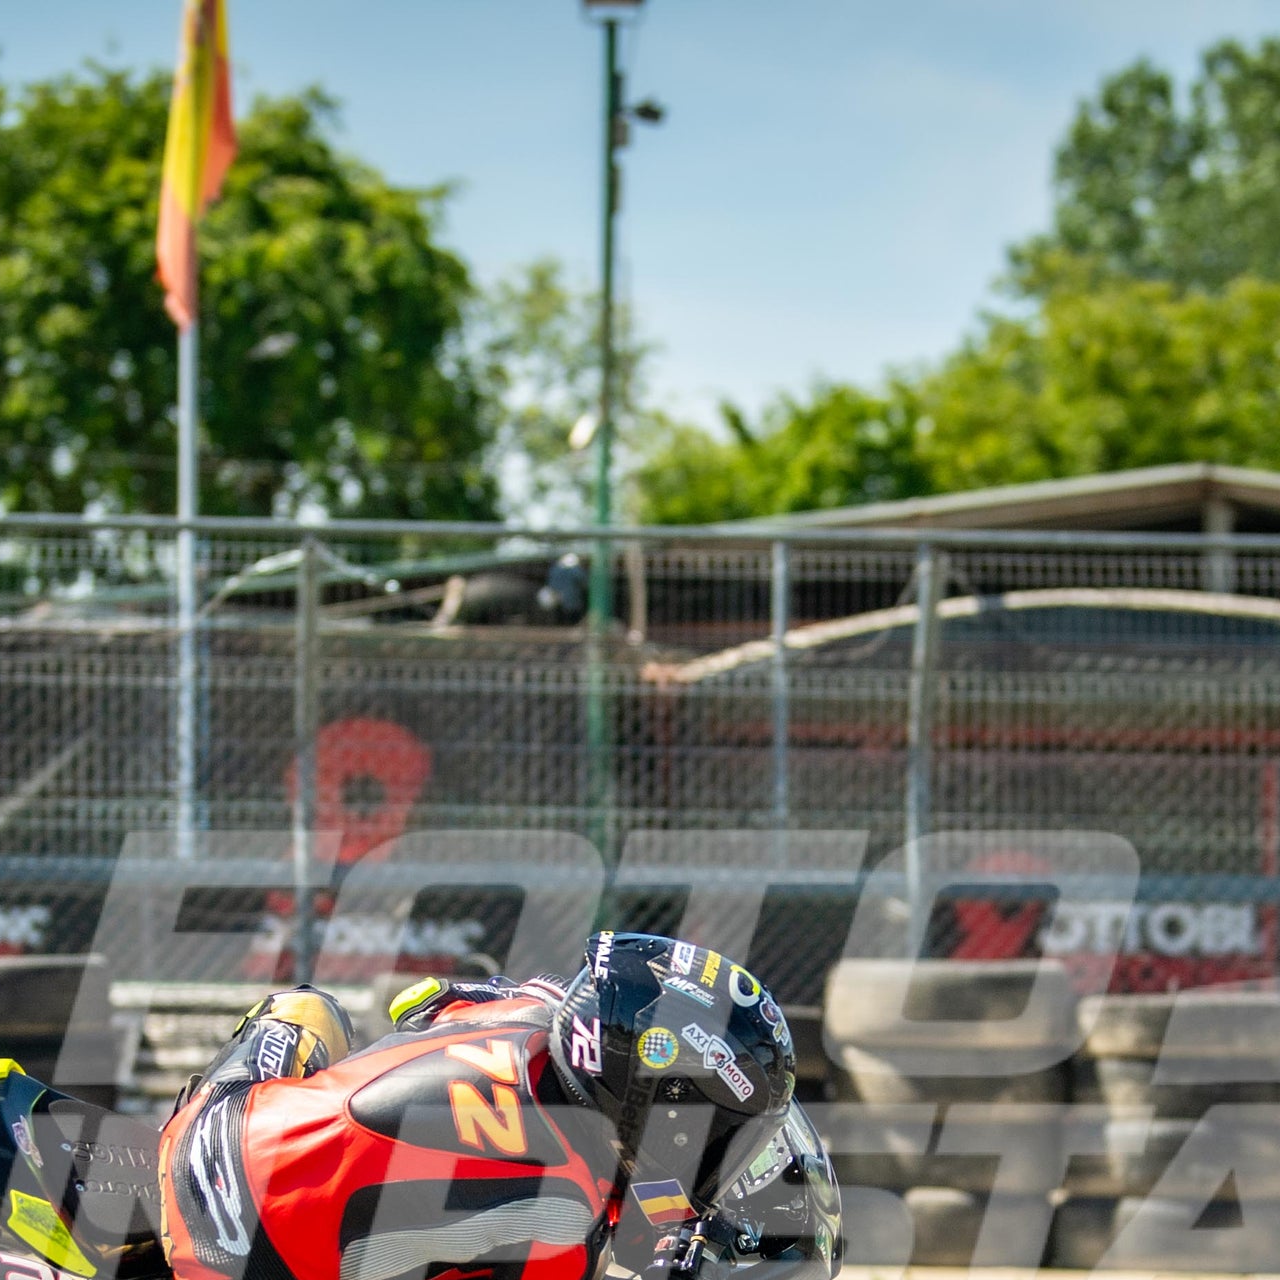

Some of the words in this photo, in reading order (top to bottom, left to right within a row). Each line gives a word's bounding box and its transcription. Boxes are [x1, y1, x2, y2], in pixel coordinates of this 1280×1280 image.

[571, 1013, 603, 1074] 72
[684, 1024, 709, 1048] AXI
[444, 1039, 528, 1156] 72
[723, 1062, 753, 1098] MOTO
